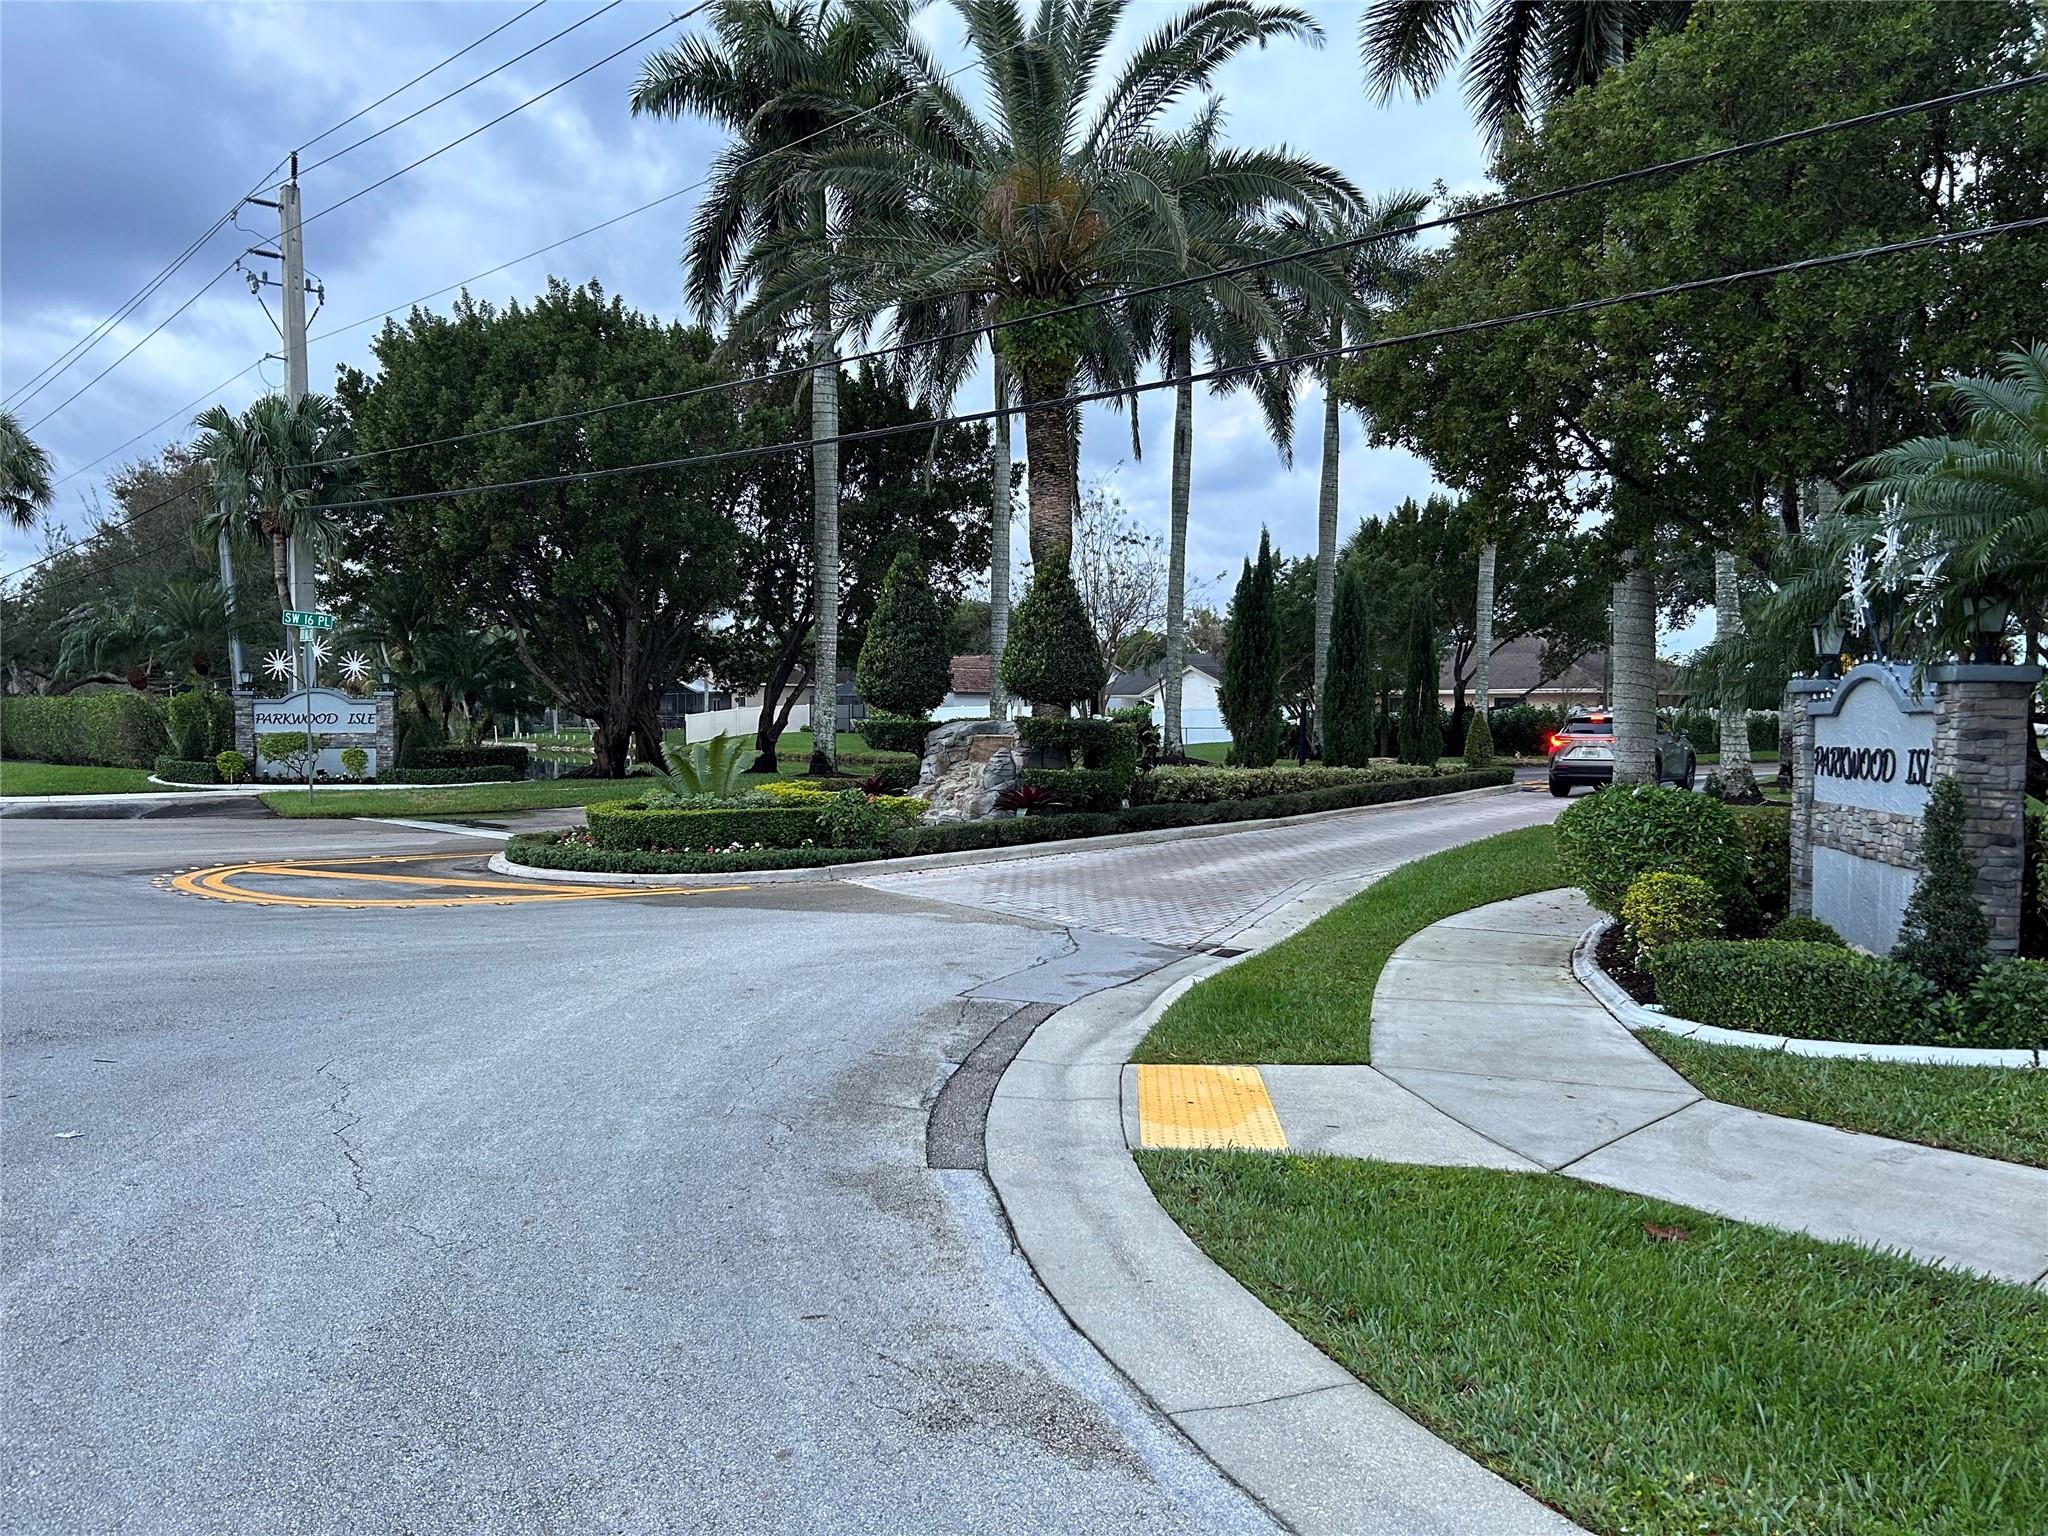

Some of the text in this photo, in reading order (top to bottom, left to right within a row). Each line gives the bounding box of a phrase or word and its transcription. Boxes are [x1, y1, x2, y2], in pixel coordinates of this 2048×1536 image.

[285, 612, 330, 627] SW 16 PL
[255, 713, 377, 725] PARKWOOD ISLE
[1814, 746, 1935, 787] PARKWOOD ISL
